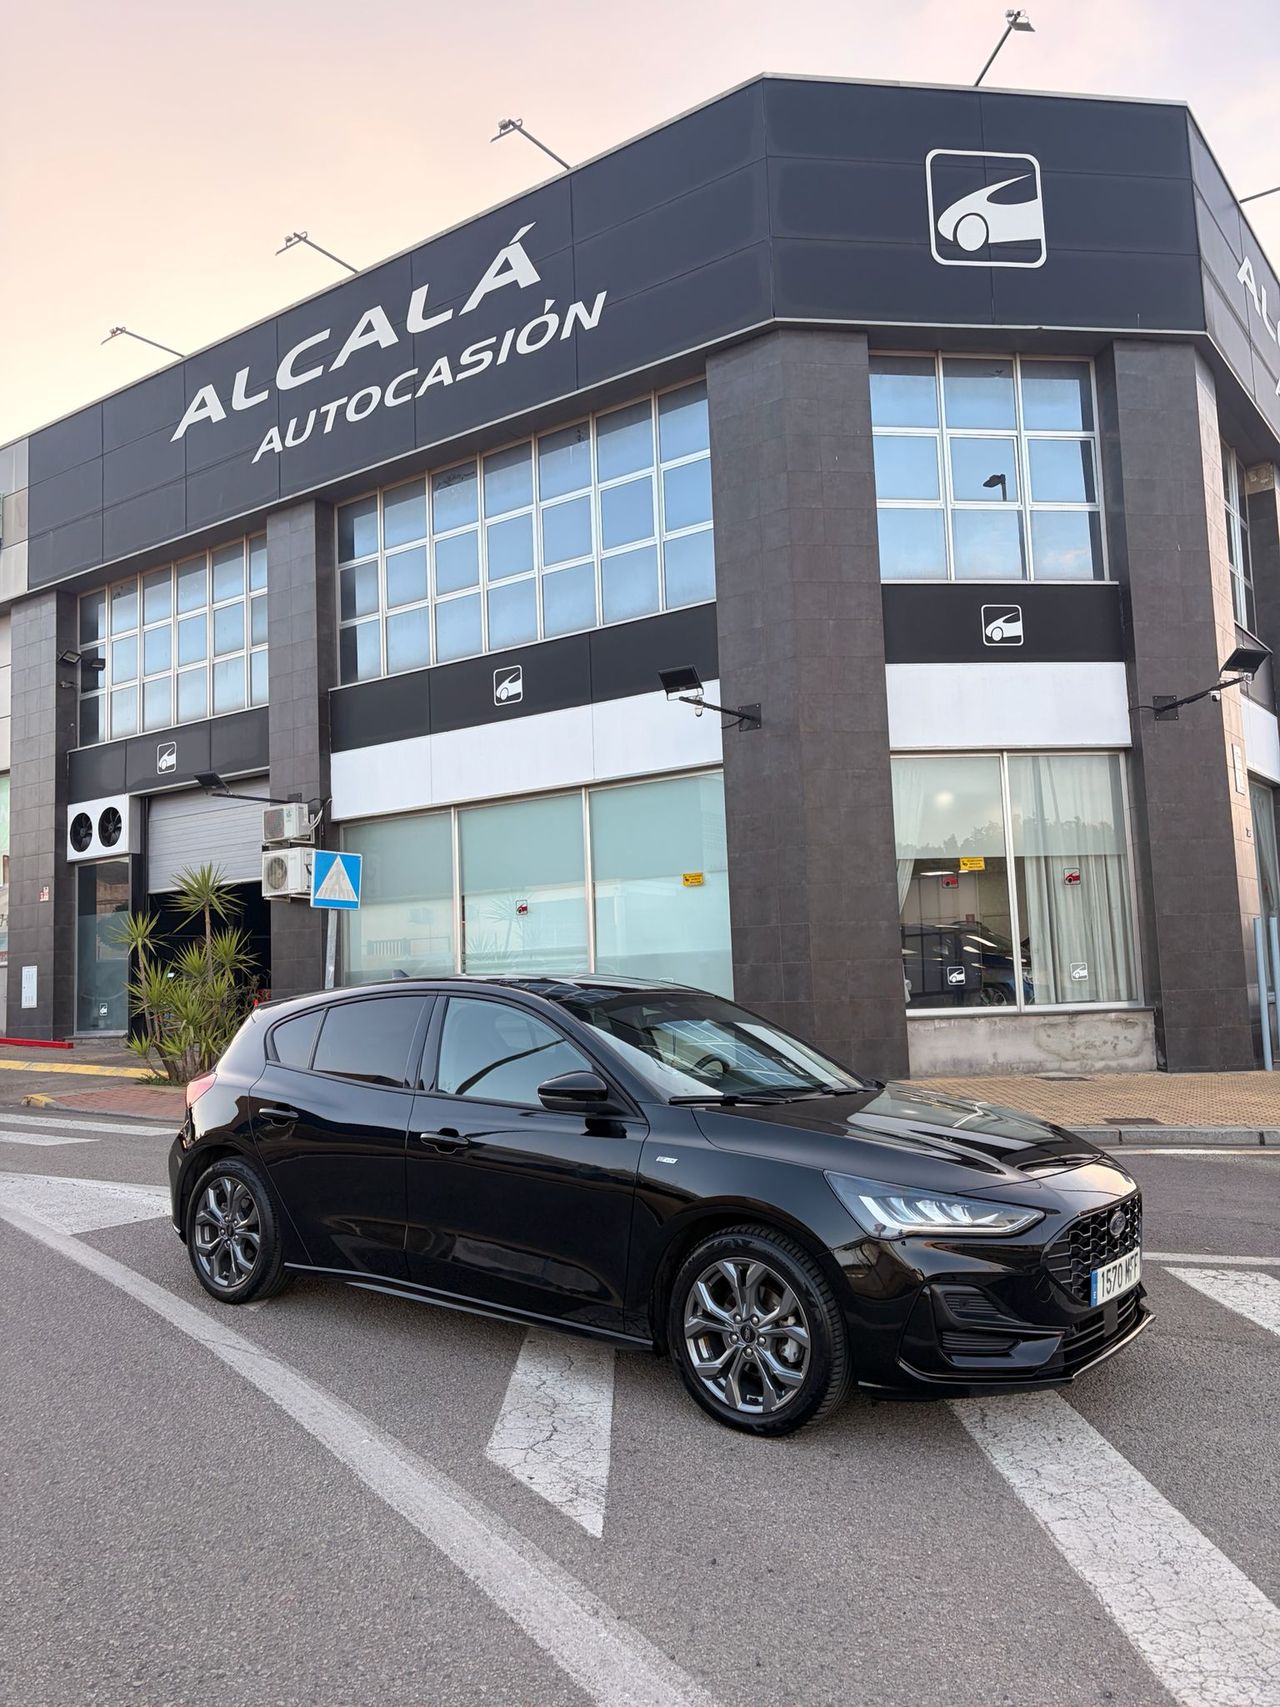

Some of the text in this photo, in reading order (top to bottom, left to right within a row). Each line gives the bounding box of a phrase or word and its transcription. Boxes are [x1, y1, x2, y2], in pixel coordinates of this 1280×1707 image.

[170, 221, 542, 442] ALCALÁ
[1236, 255, 1280, 348] AL
[251, 290, 608, 464] AUTOCASIÓN
[1101, 1263, 1123, 1298] 1570
